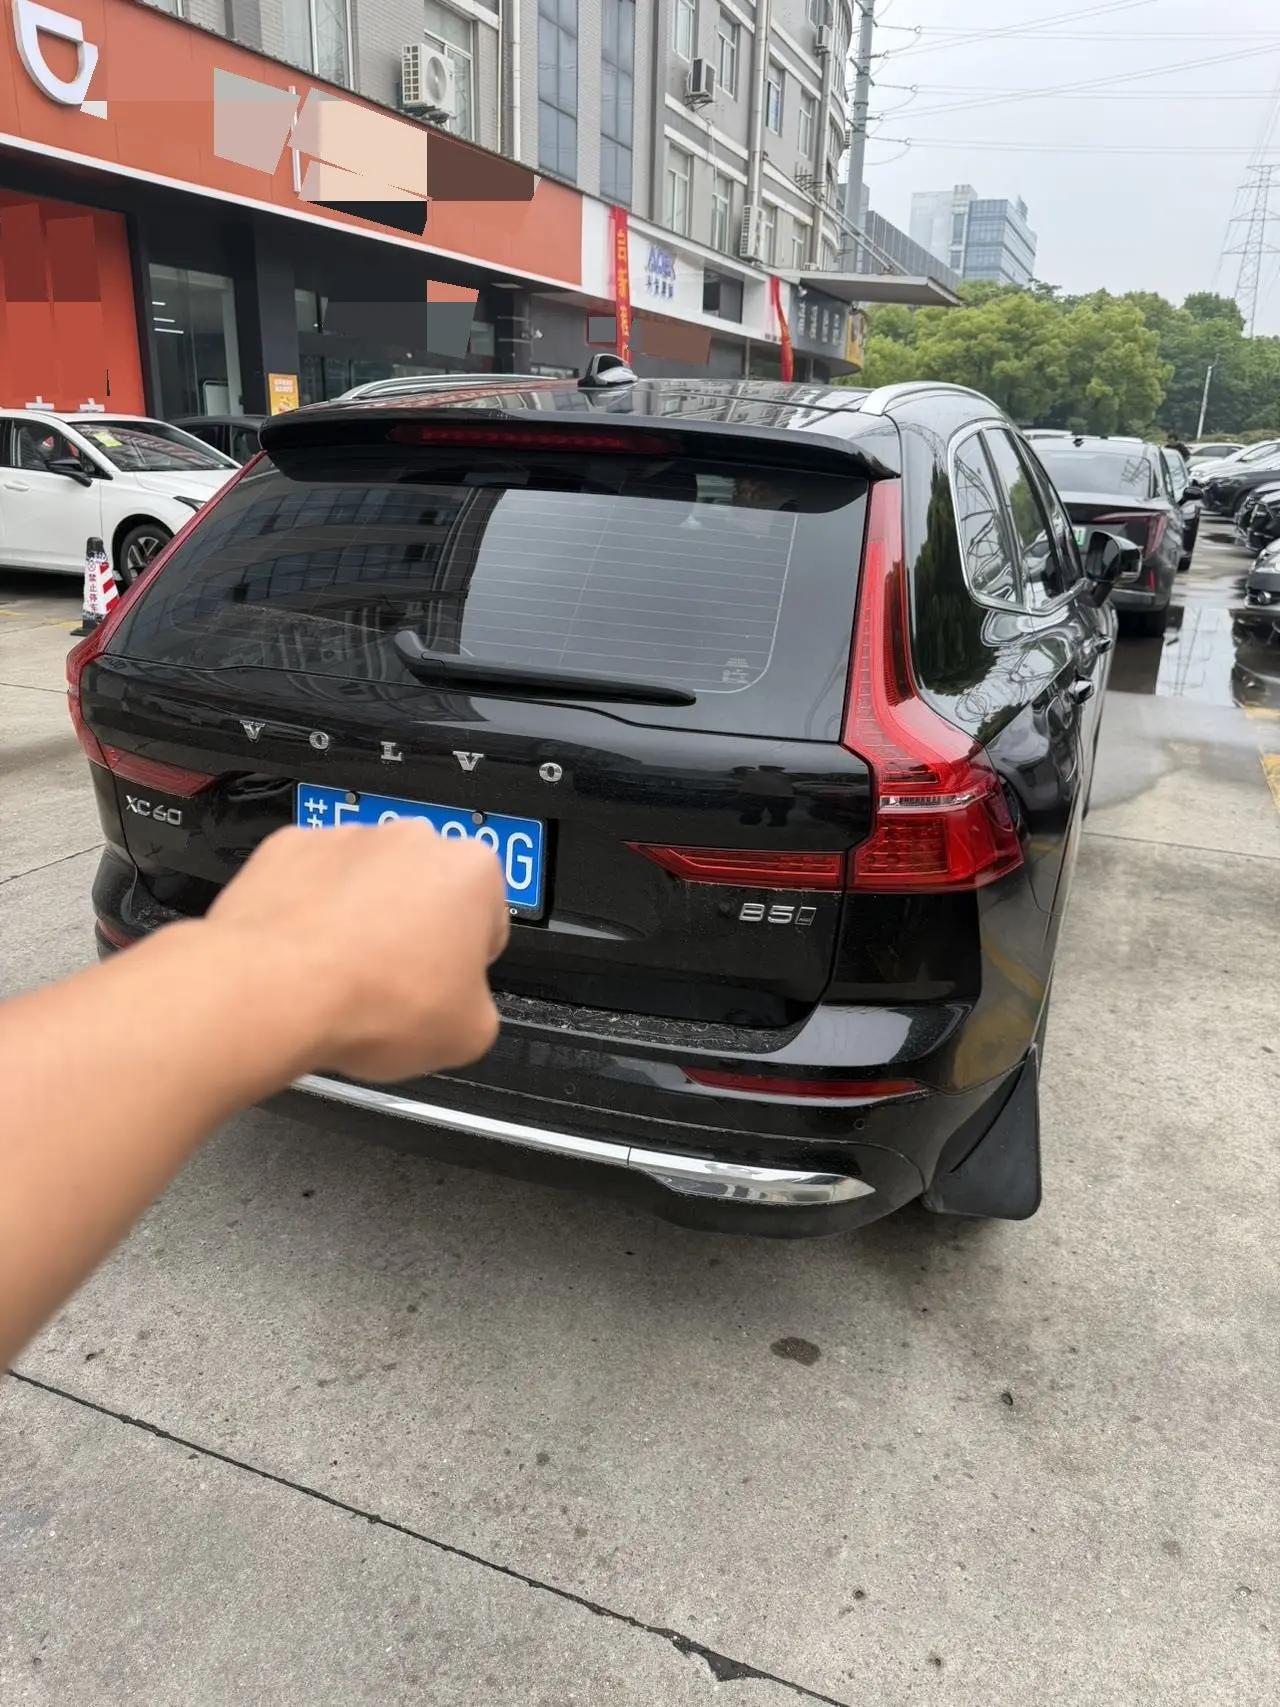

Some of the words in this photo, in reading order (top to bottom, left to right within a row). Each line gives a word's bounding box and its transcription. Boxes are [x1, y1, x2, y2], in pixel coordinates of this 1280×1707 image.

[88, 573, 98, 612] 禁止停车
[240, 720, 563, 783] VOLVO
[126, 795, 182, 825] XC60
[739, 903, 795, 923] B5
